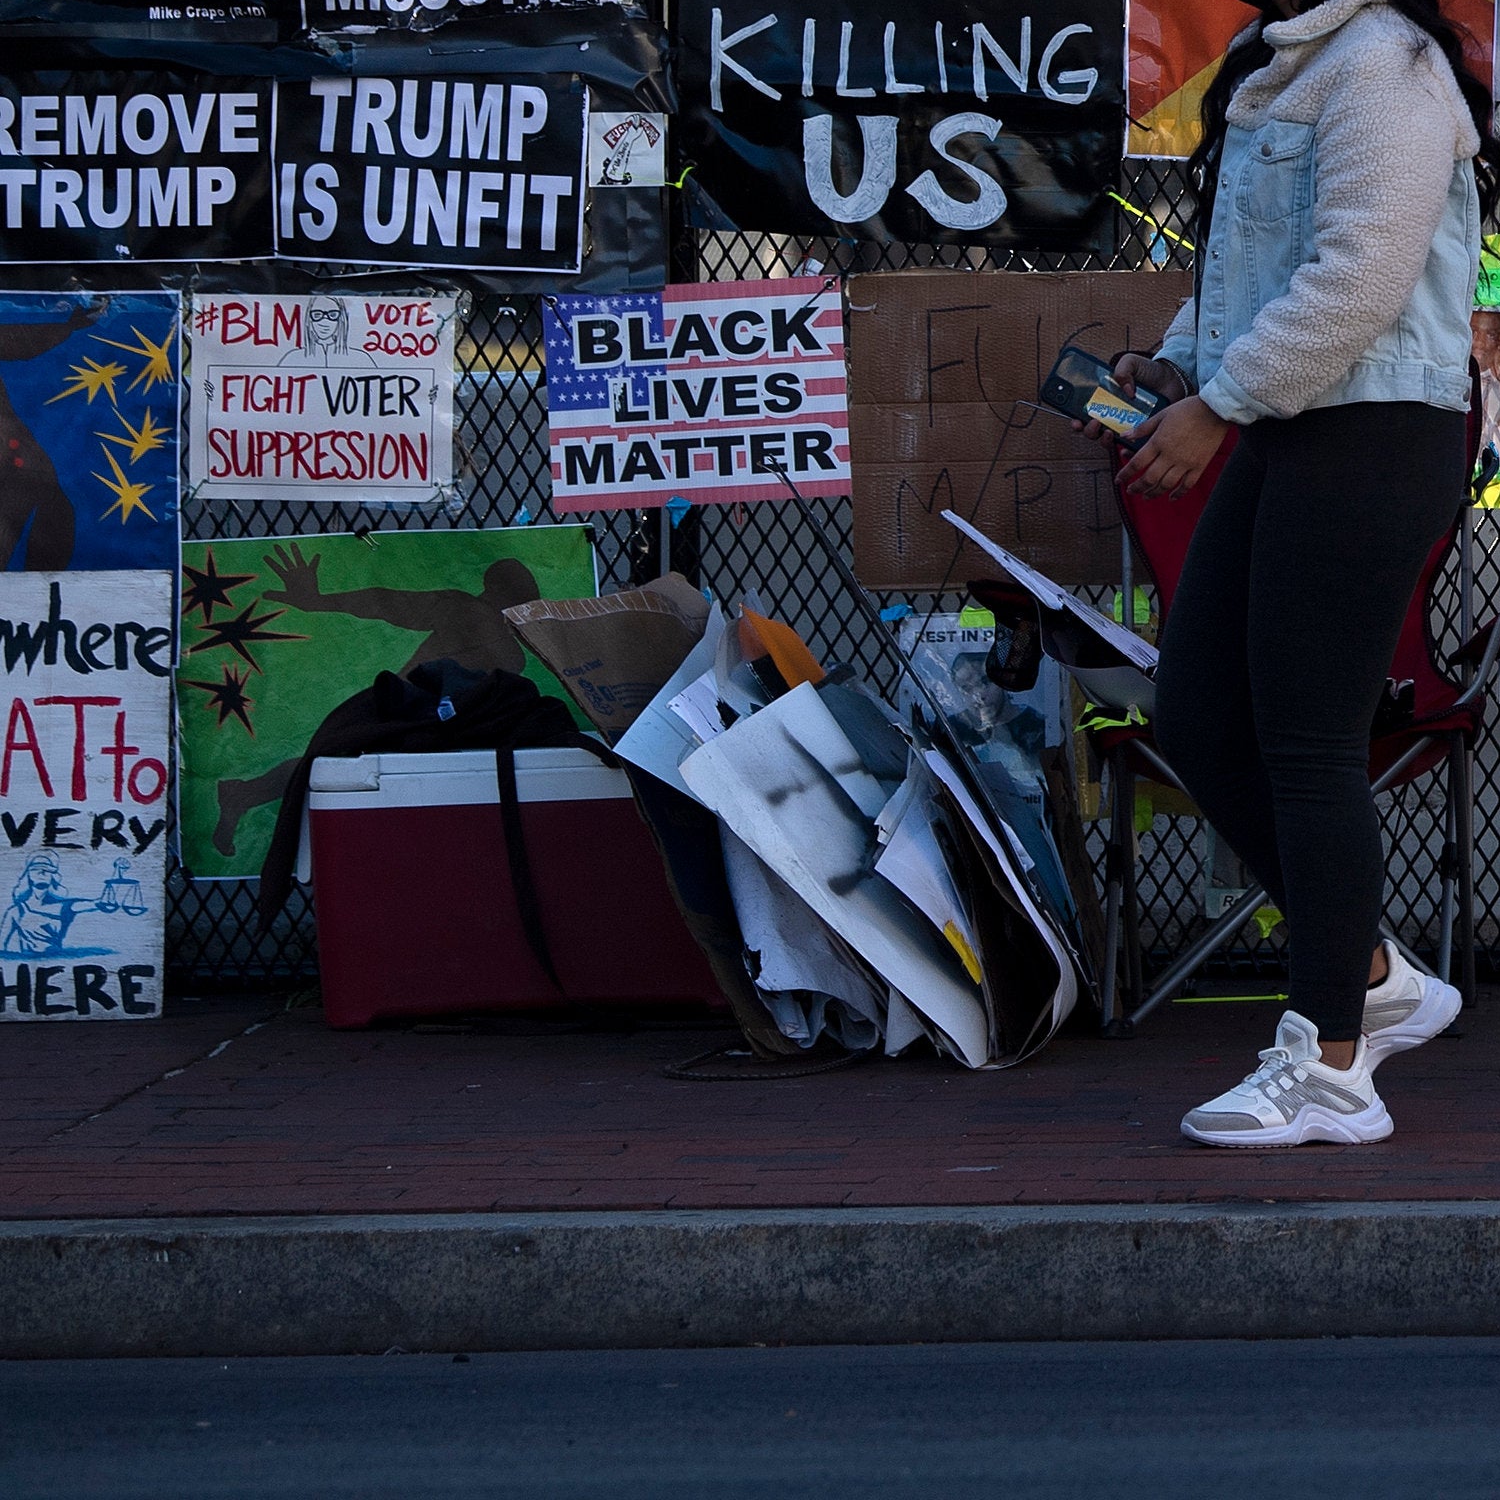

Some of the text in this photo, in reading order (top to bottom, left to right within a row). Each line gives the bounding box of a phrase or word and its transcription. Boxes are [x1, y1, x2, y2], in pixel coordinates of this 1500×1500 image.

[711, 7, 1098, 112] KILLING
[803, 112, 1007, 230] US
[194, 302, 302, 348] #BLM
[366, 303, 434, 326] VOTE
[363, 331, 437, 356] 2020
[221, 375, 421, 418] FIGHT VOTER
[208, 428, 427, 480] SUPPRESSION
